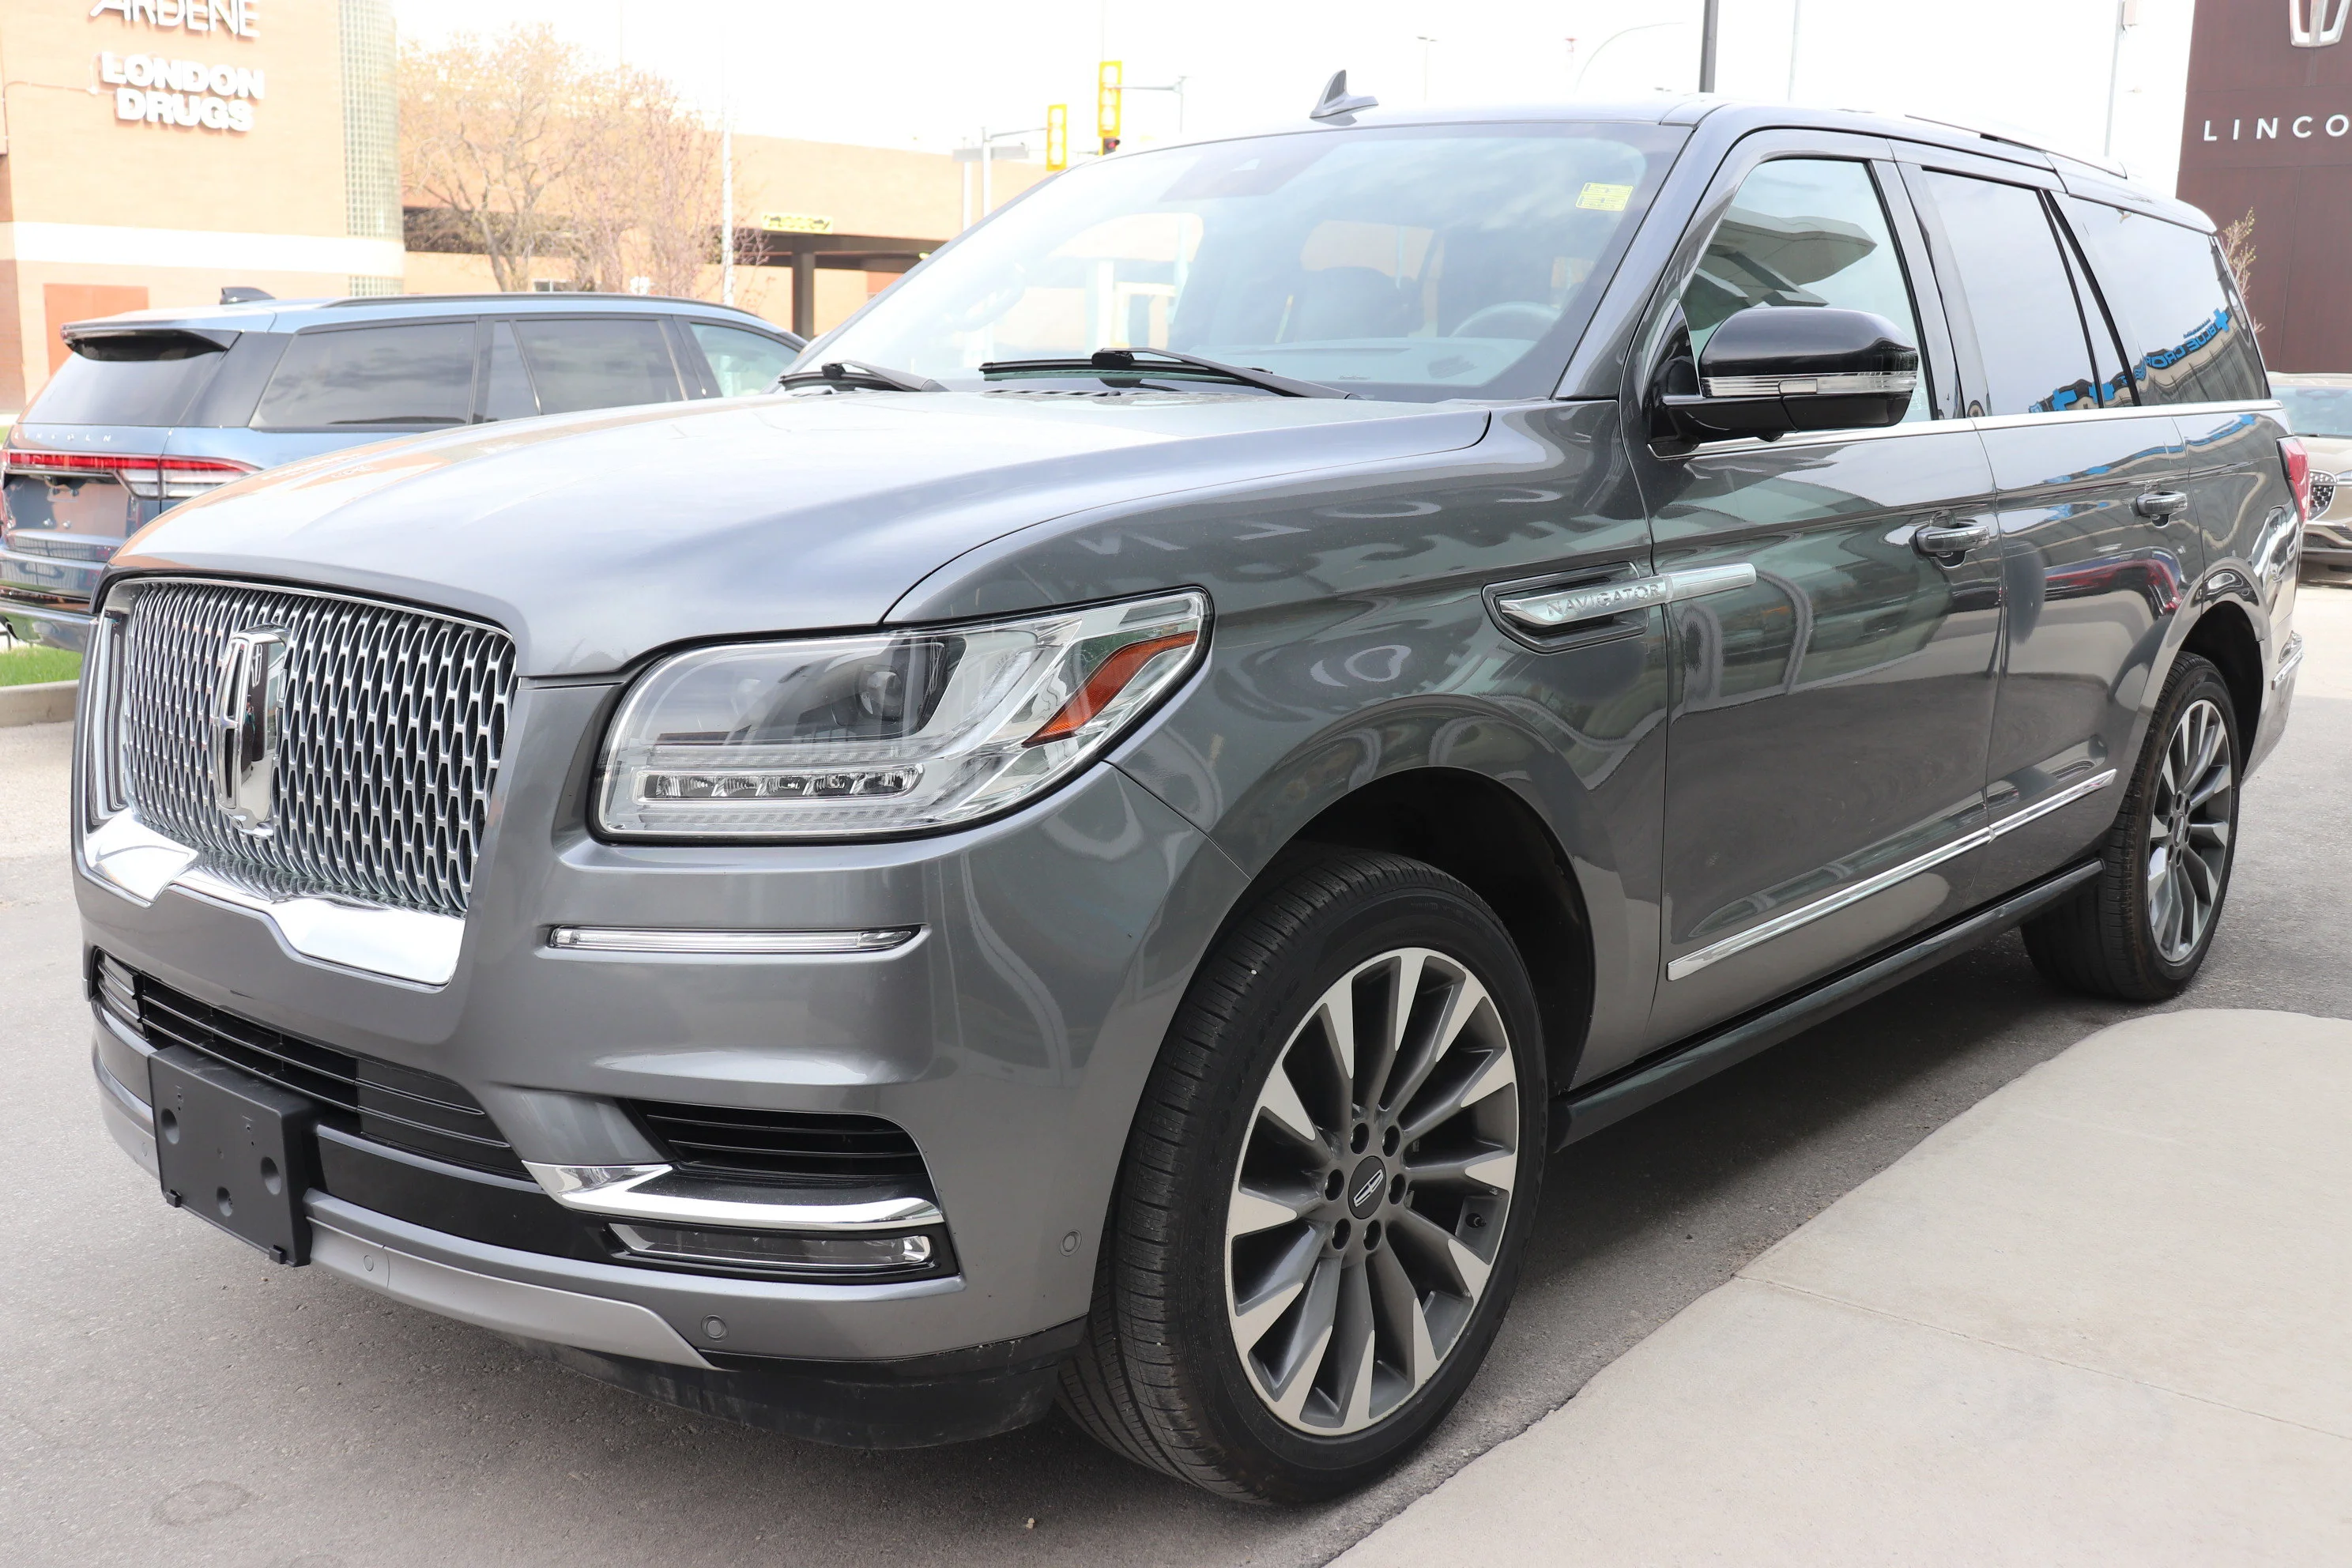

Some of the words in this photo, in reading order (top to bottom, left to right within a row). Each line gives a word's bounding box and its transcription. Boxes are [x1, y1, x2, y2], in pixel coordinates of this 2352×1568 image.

[101, 51, 264, 99] LONDON
[117, 87, 254, 131] DRUGS
[2203, 114, 2350, 141] LINCO
[1546, 584, 1660, 616] NAVIGATOR
